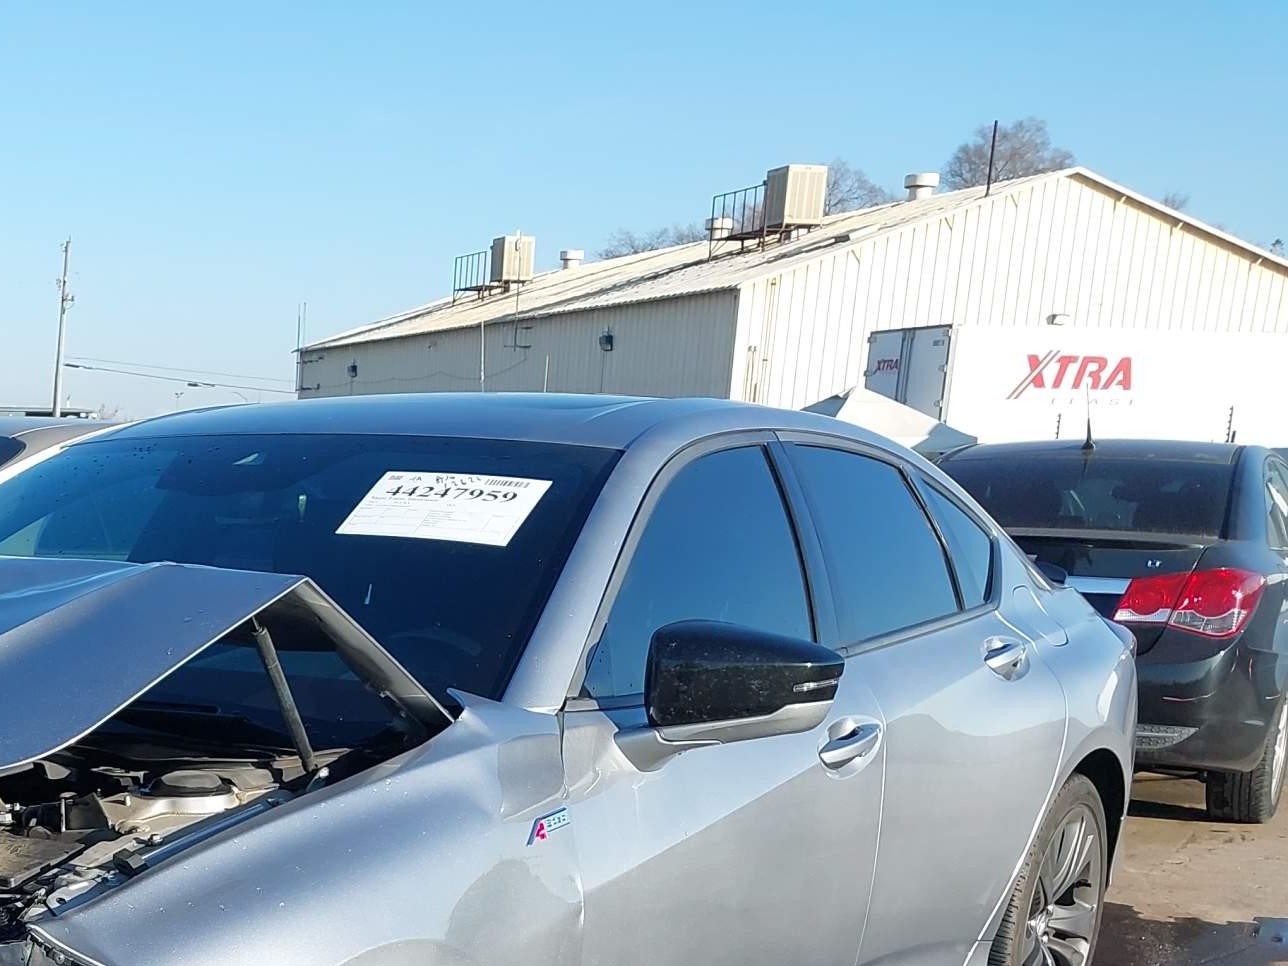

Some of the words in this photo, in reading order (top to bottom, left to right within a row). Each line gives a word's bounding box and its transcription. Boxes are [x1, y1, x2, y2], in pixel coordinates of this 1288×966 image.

[872, 358, 900, 375] XTRA
[1006, 350, 1132, 399] XTRA
[386, 485, 518, 503] 44247959
